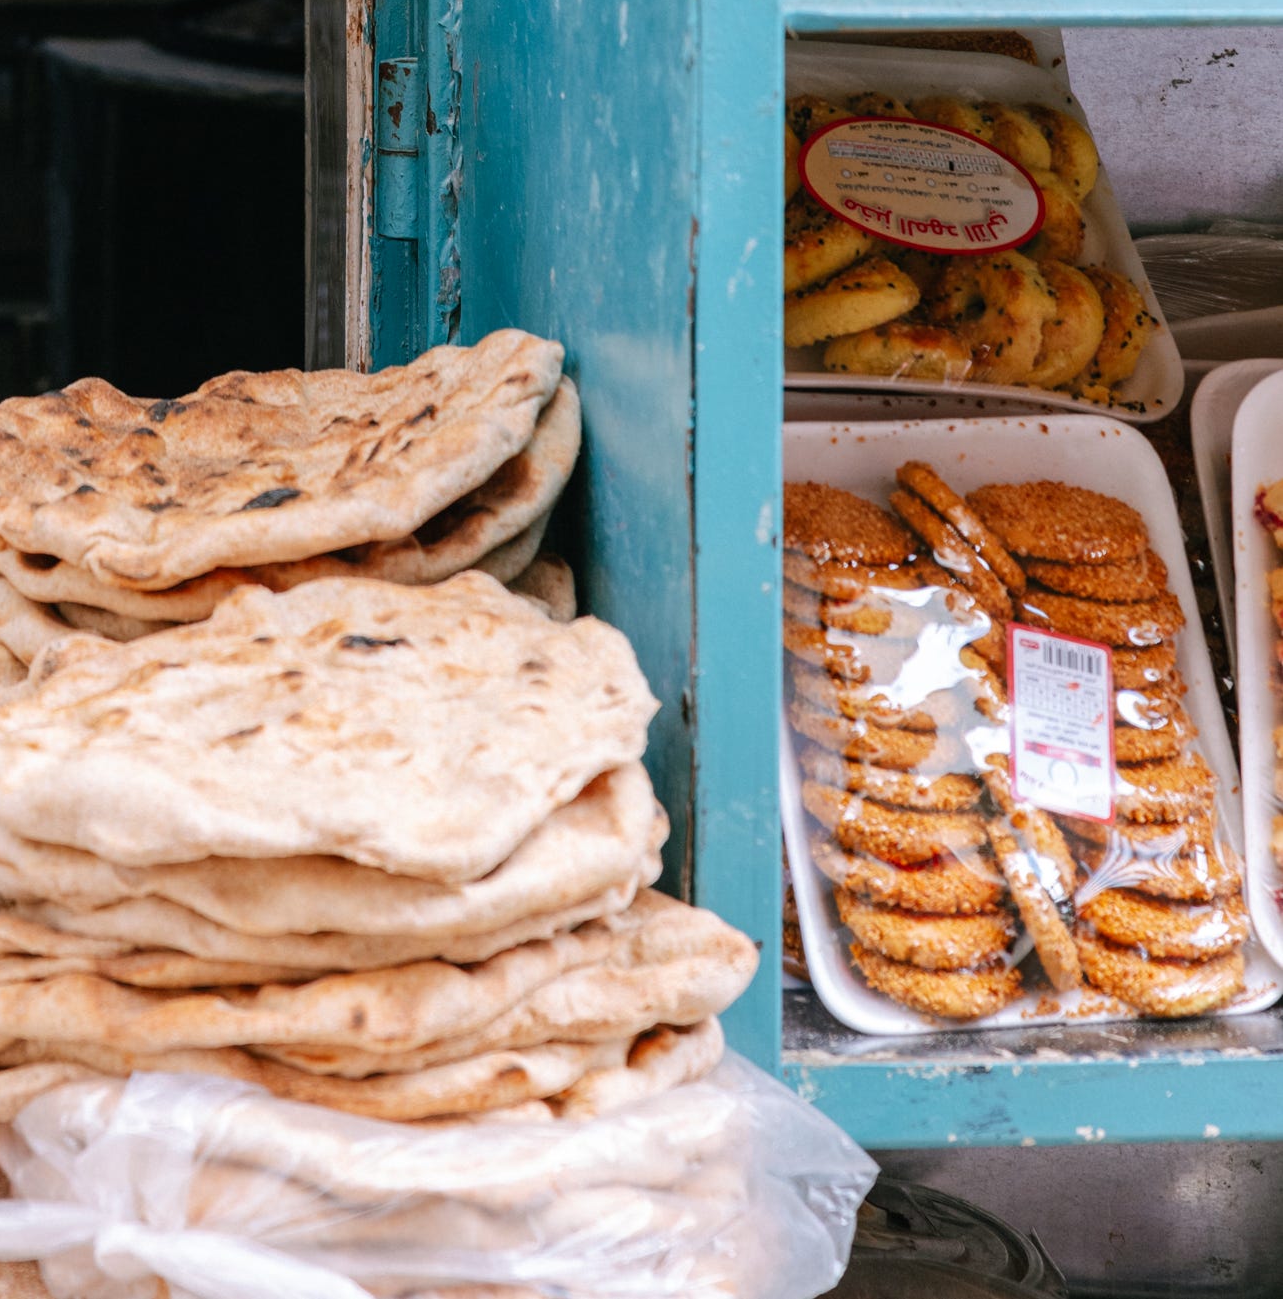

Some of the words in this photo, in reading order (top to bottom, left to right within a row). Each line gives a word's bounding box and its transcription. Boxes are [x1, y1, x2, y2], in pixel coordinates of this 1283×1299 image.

[844, 198, 893, 230] مخبز
[900, 218, 958, 236] المهد
[964, 210, 1008, 242] الآلي
